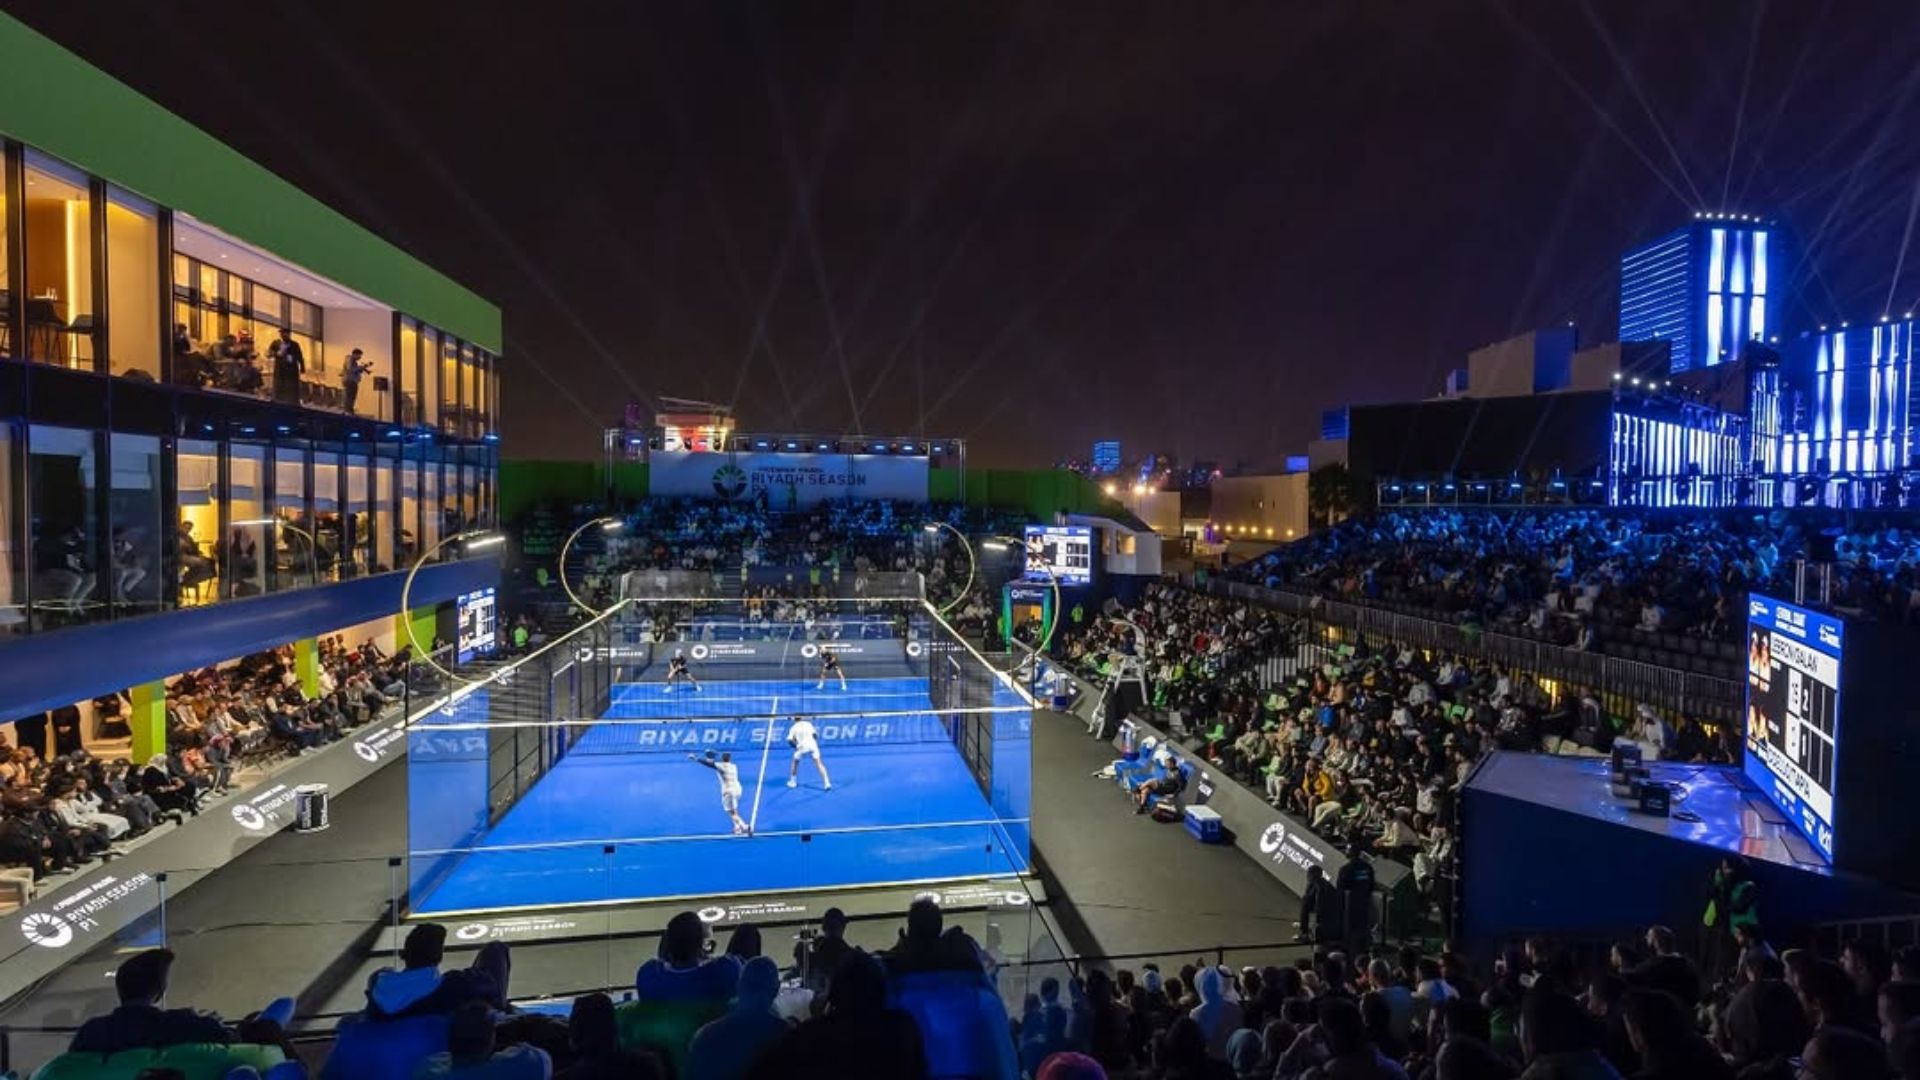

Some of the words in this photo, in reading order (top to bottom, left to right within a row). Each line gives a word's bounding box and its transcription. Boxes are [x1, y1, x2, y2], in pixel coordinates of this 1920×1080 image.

[751, 472, 804, 485] RIYADH
[808, 473, 867, 486] SEASON
[1802, 688, 1809, 712] 2
[639, 728, 738, 745] RIYADH
[751, 725, 858, 742] SEON
[864, 724, 889, 739] P1
[1802, 733, 1807, 757] 1
[66, 894, 112, 923] RIYADH
[106, 871, 153, 900] SEASON
[78, 917, 99, 932] P1
